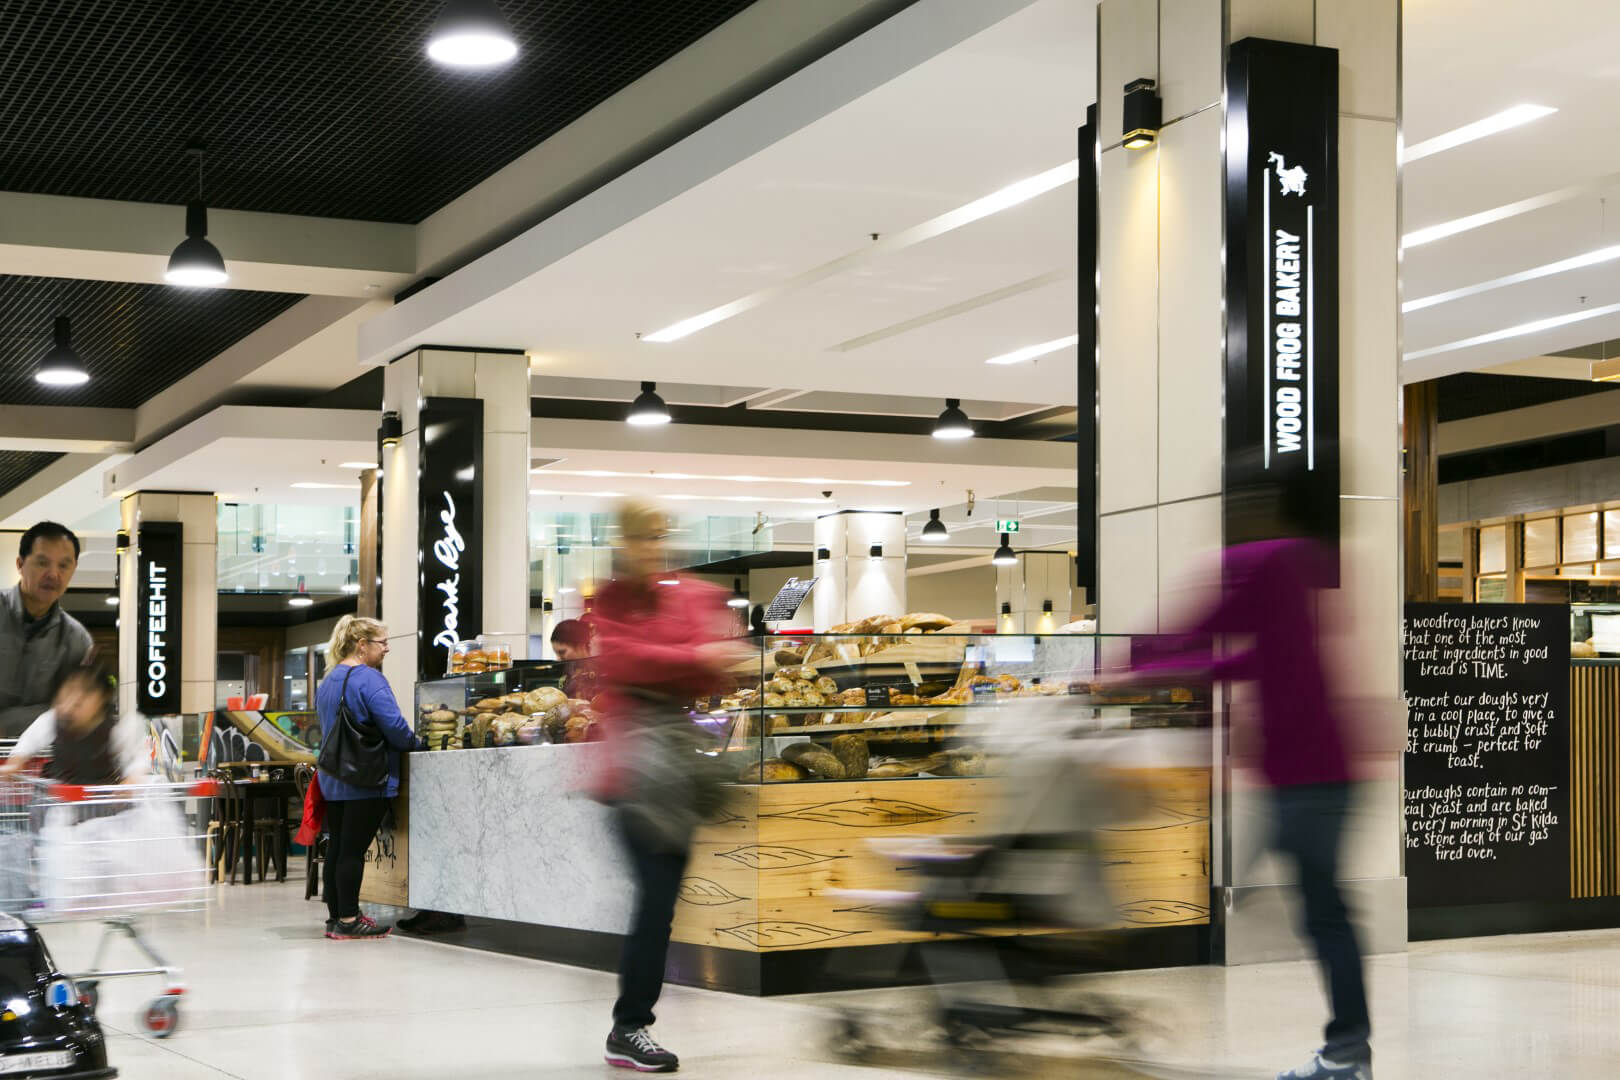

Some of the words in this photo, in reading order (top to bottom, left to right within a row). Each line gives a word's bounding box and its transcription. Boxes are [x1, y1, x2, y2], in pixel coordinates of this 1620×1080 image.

[1275, 229, 1301, 317] BAKERY
[1276, 322, 1302, 381] FROG
[1276, 386, 1302, 454] WOOD
[433, 490, 465, 570] Rye
[433, 572, 460, 648] Dark
[148, 561, 167, 698] COFFEEHIT
[1414, 613, 1466, 633] woodfrog
[1472, 616, 1508, 631] bakers
[1513, 617, 1540, 631] know
[1403, 630, 1430, 645] that
[1435, 633, 1453, 644] one
[1459, 628, 1471, 644] of
[1476, 630, 1494, 645] the
[1500, 630, 1526, 645] most
[1405, 646, 1439, 660] rtant
[1444, 645, 1505, 662] ingredients
[1510, 645, 1519, 659] in
[1524, 646, 1547, 664] good
[1421, 661, 1453, 676] bread
[1459, 661, 1467, 674] is
[1472, 661, 1508, 679] TIME.
[1454, 695, 1474, 706] our
[1479, 691, 1517, 710] doughs
[1522, 692, 1548, 708] very
[1415, 707, 1424, 722] in
[1429, 712, 1436, 721] a
[1441, 709, 1462, 724] cool
[1467, 710, 1500, 725] place,
[1506, 706, 1517, 721] to
[1521, 706, 1542, 725] give
[1548, 710, 1554, 719] a
[1424, 724, 1461, 739] bubbly
[1465, 722, 1495, 737] crust
[1500, 722, 1520, 735] and
[1525, 721, 1548, 736] soft
[1424, 739, 1457, 753] crumb
[1477, 735, 1519, 754] perfect
[1524, 735, 1541, 750] for
[1448, 754, 1483, 768] toast.
[1467, 782, 1507, 798] contain
[1512, 785, 1524, 795] no
[1429, 799, 1462, 818] yeast
[1467, 799, 1487, 812] and
[1492, 801, 1511, 812] are
[1516, 797, 1547, 813] baked
[1413, 817, 1446, 833] every
[1451, 813, 1494, 832] morning
[1499, 813, 1507, 828] in
[1512, 812, 1527, 831] St
[1532, 811, 1558, 829] Kilda
[1424, 831, 1455, 846] stone
[1460, 831, 1484, 845] deck
[1489, 827, 1501, 842] of
[1505, 831, 1525, 841] our
[1529, 827, 1548, 846] gas
[1436, 844, 1462, 860] fired
[1468, 848, 1496, 860] oven.
